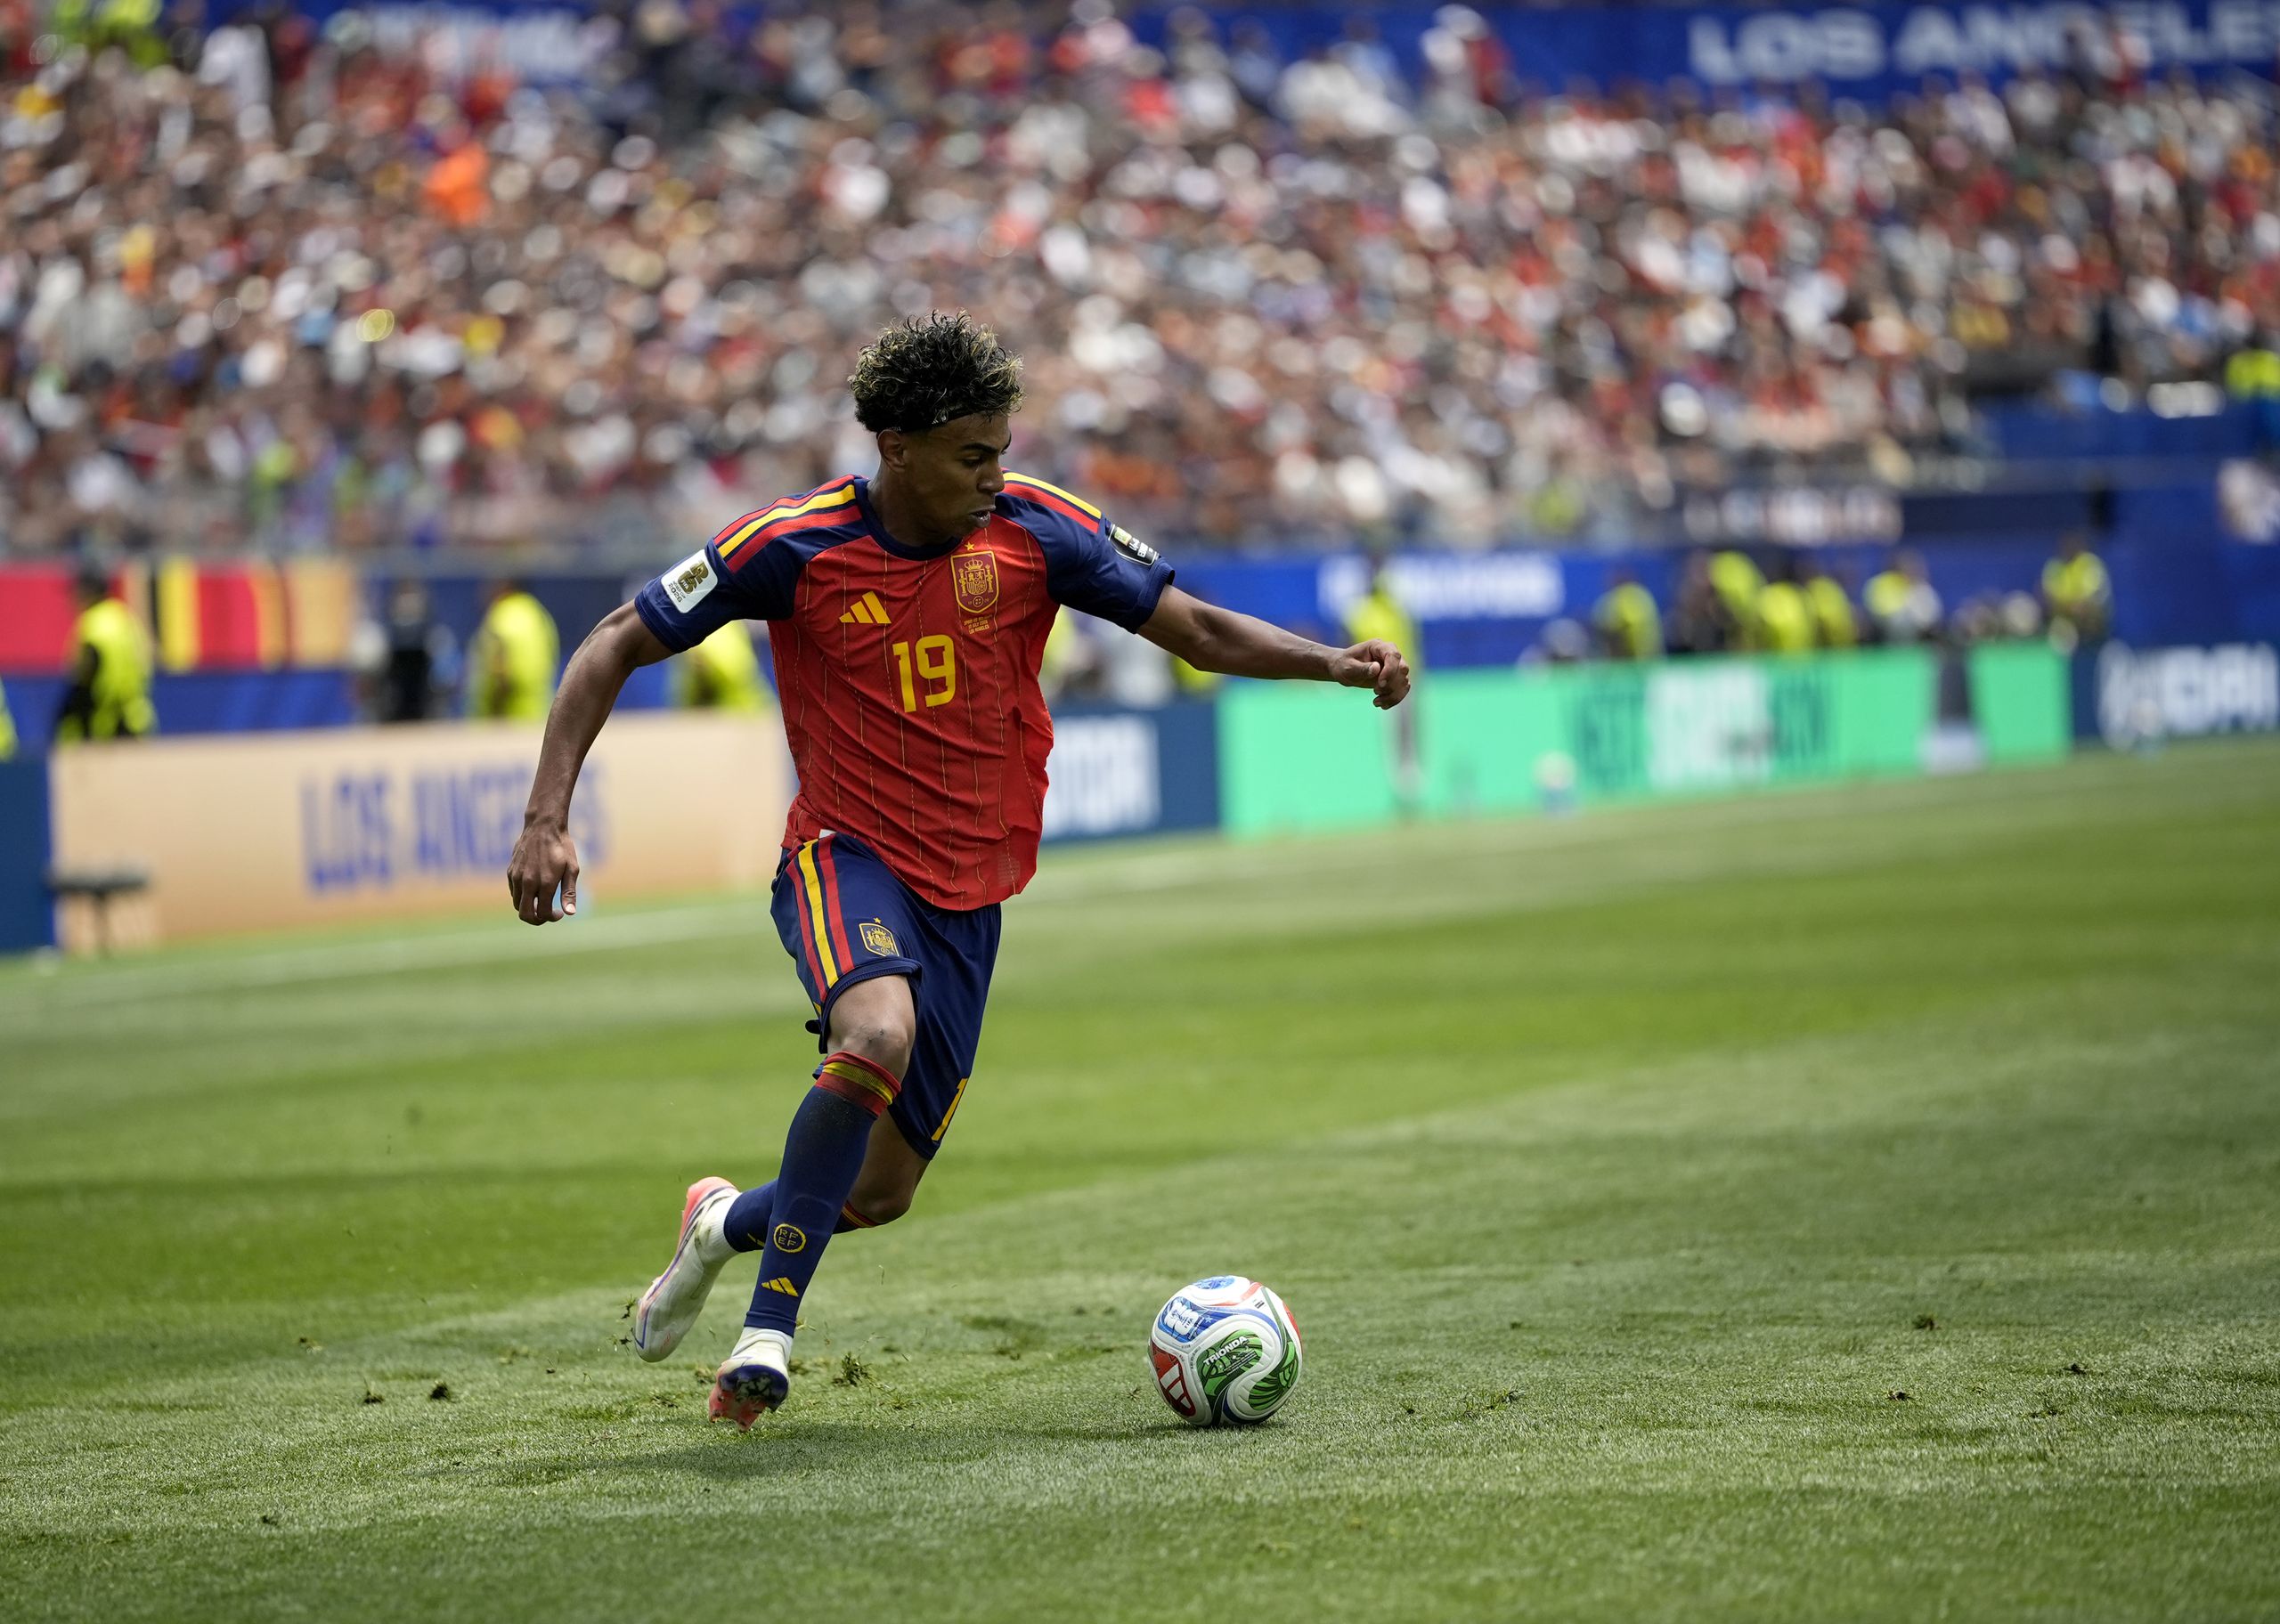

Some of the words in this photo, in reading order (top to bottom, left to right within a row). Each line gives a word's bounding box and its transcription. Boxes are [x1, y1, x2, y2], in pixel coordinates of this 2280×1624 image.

[1689, 9, 1886, 85] LOS
[669, 582, 683, 603] 2026
[892, 634, 956, 713] 19
[300, 771, 395, 893] LOS
[1202, 1336, 1248, 1366] TRIONDA
